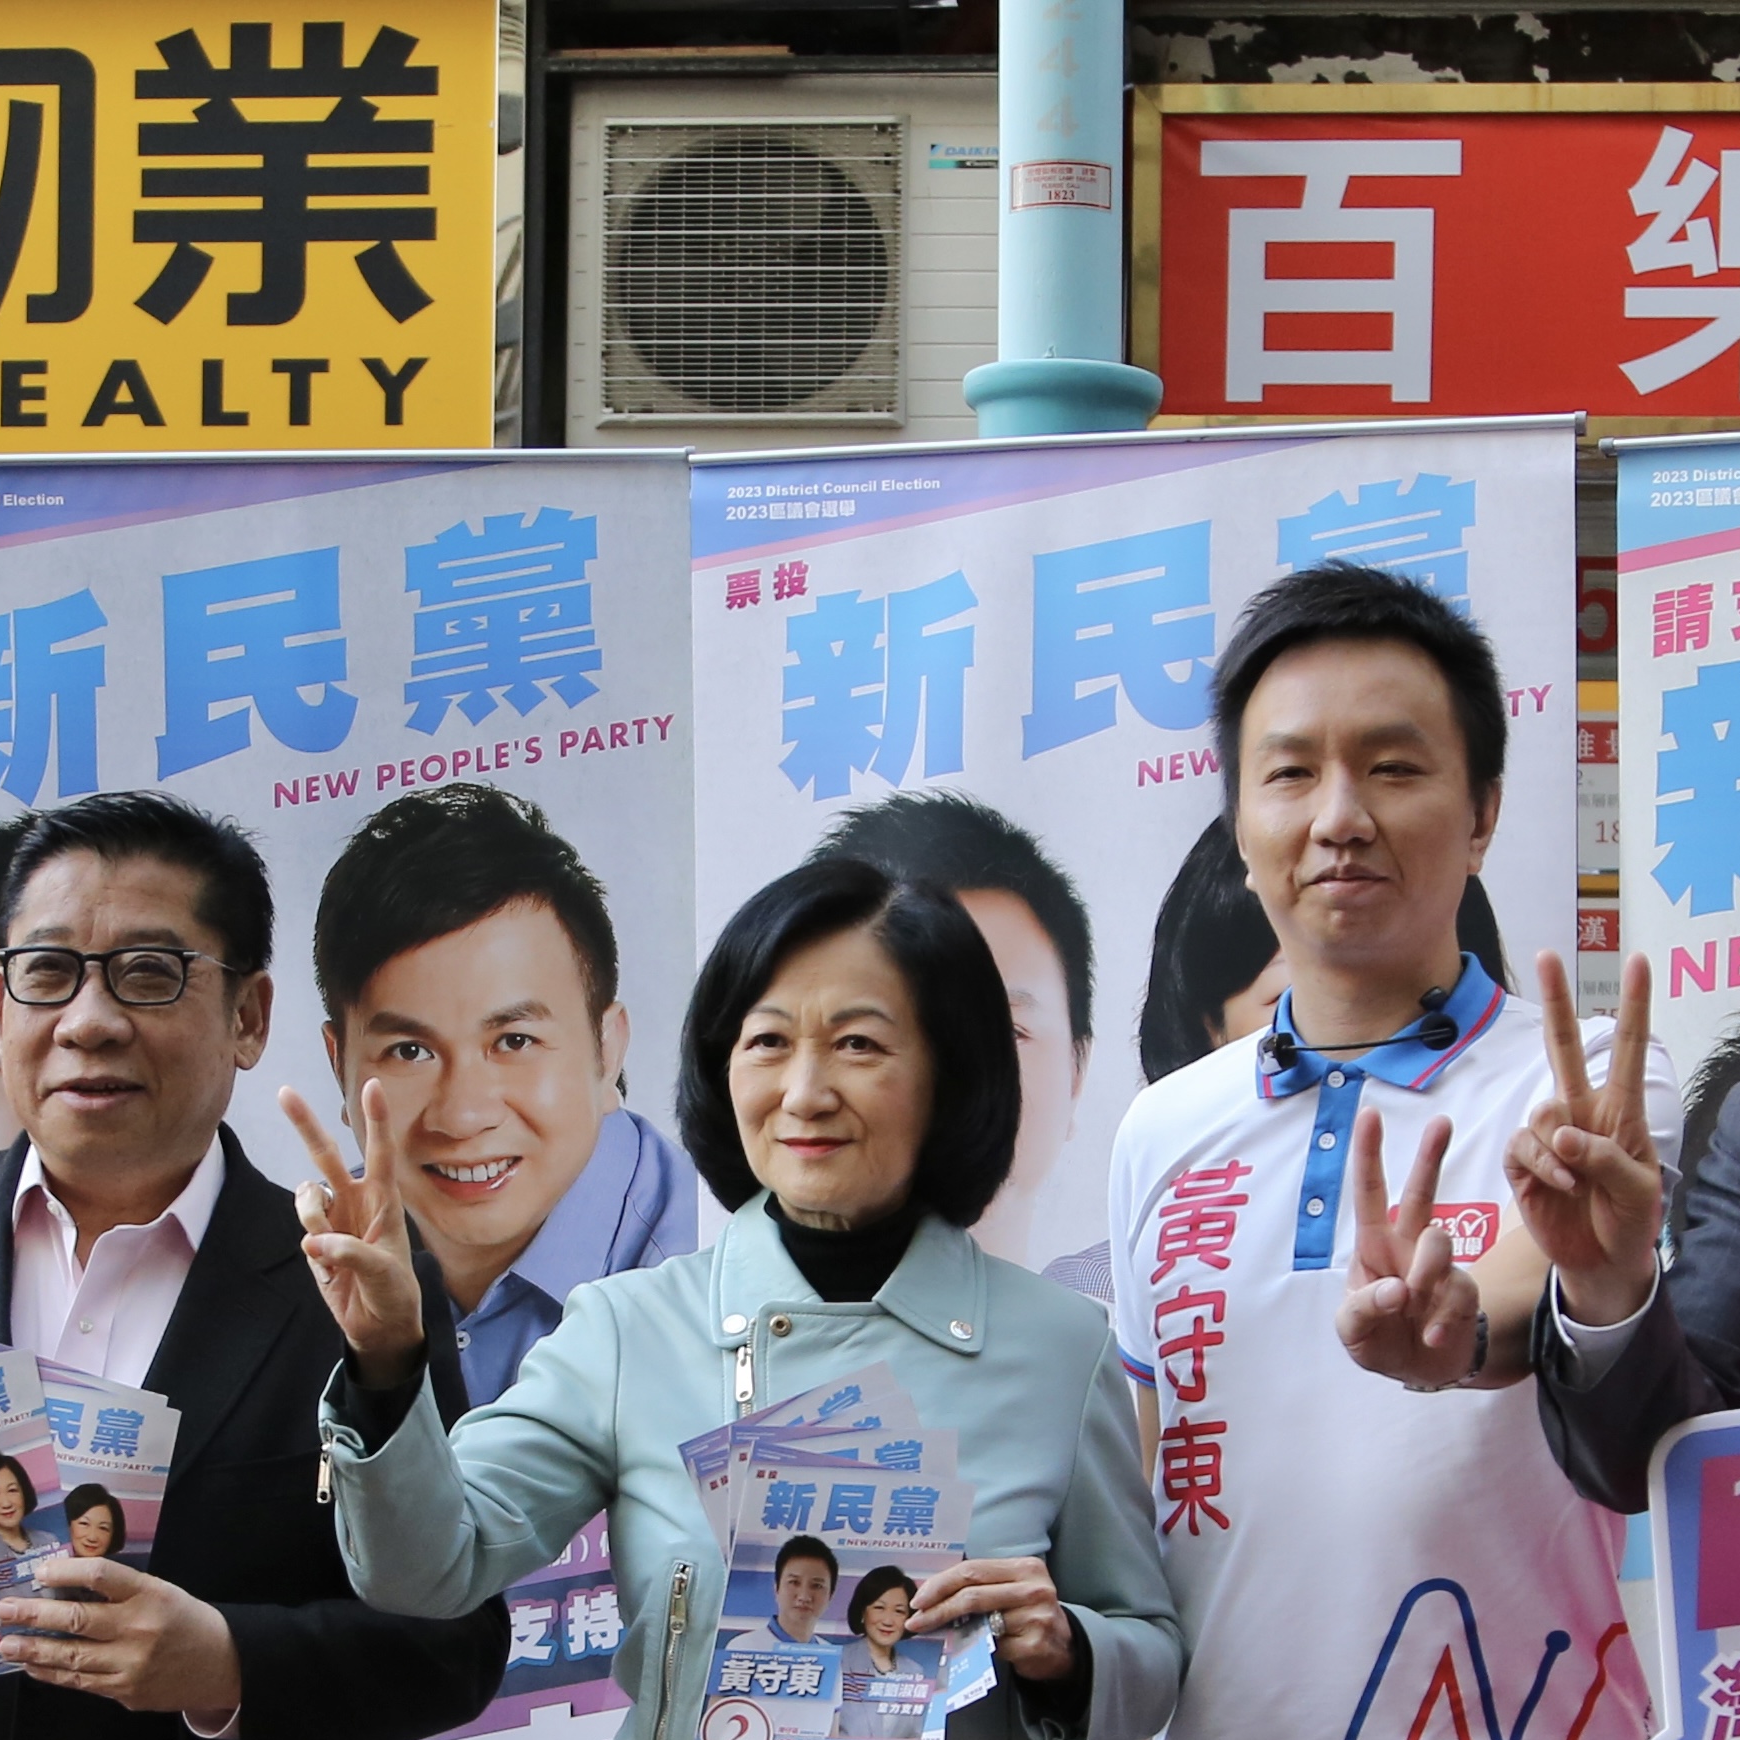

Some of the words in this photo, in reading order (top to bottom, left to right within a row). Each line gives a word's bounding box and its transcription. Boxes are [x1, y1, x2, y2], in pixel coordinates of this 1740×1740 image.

[1048, 189, 1075, 201] 1823
[728, 486, 762, 499] 2023
[766, 483, 821, 498] District
[825, 480, 877, 495] Council
[881, 476, 941, 492] Election
[1653, 469, 1689, 485] 2023
[3, 491, 65, 507] Election
[725, 560, 810, 611] 票投
[273, 765, 361, 809] NEW
[376, 735, 542, 792] PEOPLE'S
[560, 712, 674, 762] PARTY
[1150, 1159, 1253, 1537] 黃守東
[762, 1480, 940, 1537] 新民黨
[718, 1658, 825, 1696] 黃守東
